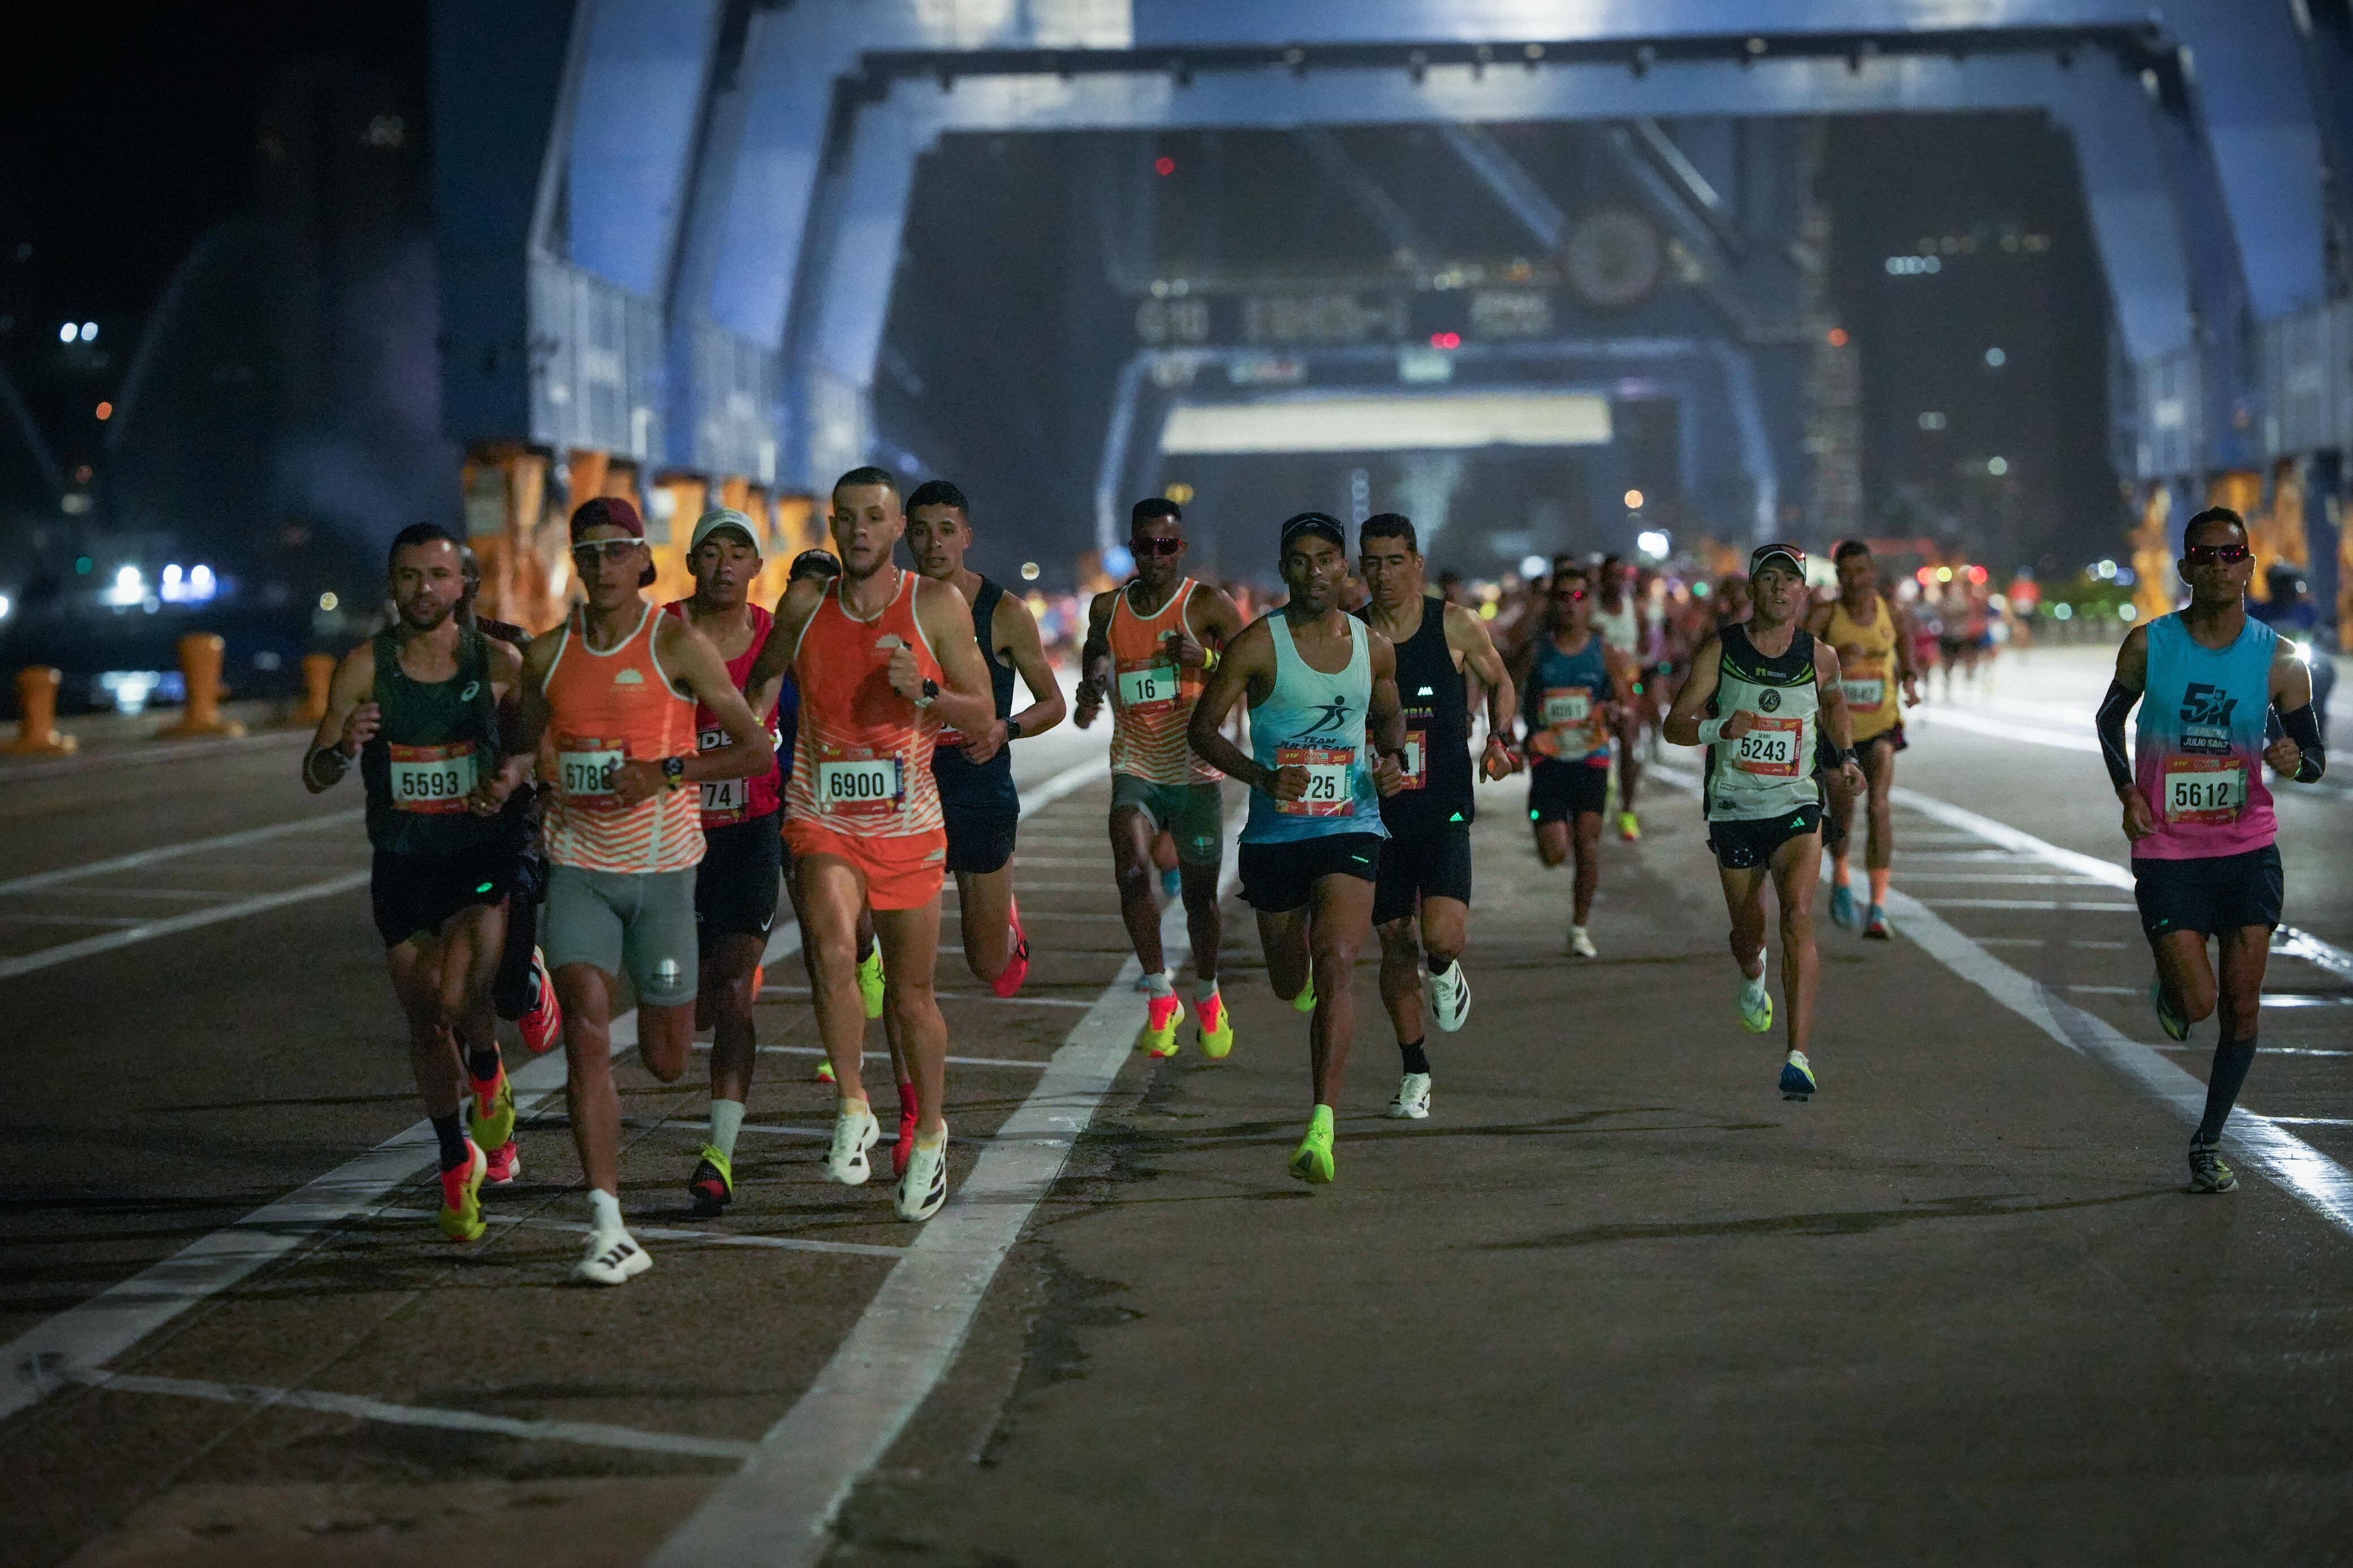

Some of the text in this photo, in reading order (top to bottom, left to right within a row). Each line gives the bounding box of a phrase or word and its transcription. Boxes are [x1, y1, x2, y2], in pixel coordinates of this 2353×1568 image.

[1136, 679, 1155, 699] 16
[1303, 736, 1337, 744] TEAM
[1740, 737, 1786, 762] 5243
[2183, 737, 2207, 746] JULIO
[402, 771, 459, 796] 5593
[831, 772, 885, 797] 6900
[2175, 782, 2229, 807] 5612
